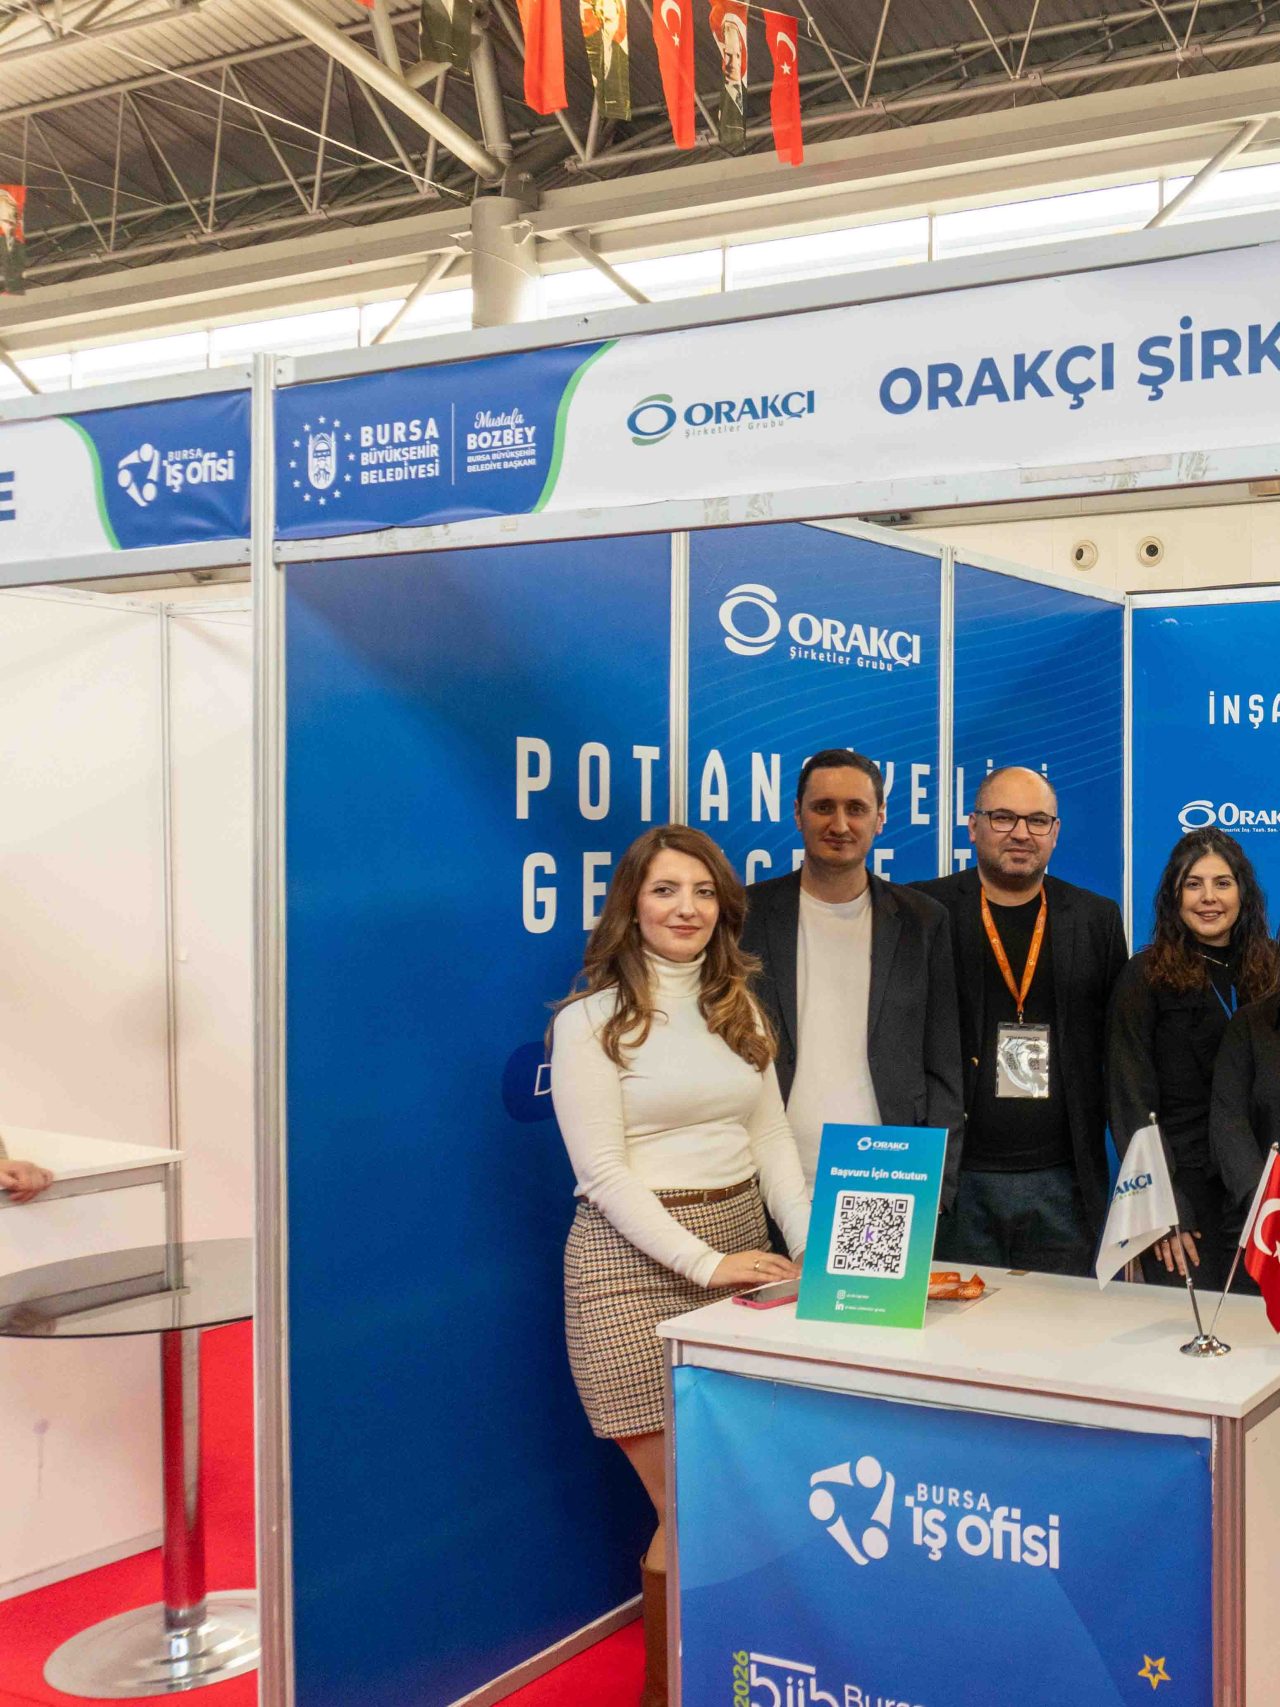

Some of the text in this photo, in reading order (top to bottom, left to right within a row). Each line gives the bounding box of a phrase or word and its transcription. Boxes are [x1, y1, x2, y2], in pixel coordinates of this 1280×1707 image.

[879, 341, 1115, 412] ORAKÇI
[474, 408, 524, 429] Mustafa
[684, 390, 815, 426] ORAKÇI
[360, 417, 440, 447] BURSA
[467, 426, 536, 450] BOZBEY
[685, 419, 784, 438] Şirketler Grubu
[168, 448, 202, 461] BURSA
[361, 440, 440, 466] BÜYÜKŞEHİR
[467, 454, 490, 463] BURSA
[467, 458, 536, 473] BELEDİYE BAŞKANI
[186, 450, 235, 484] ofisi
[361, 459, 440, 485] BELEDİYESİ
[788, 613, 920, 667] ORAKÇI
[789, 646, 893, 672] Şirketler Grubu
[830, 1166, 928, 1181] Başvuru İçin Okutun
[917, 1482, 991, 1513] BURSA
[957, 1506, 1060, 1570] ofisi
